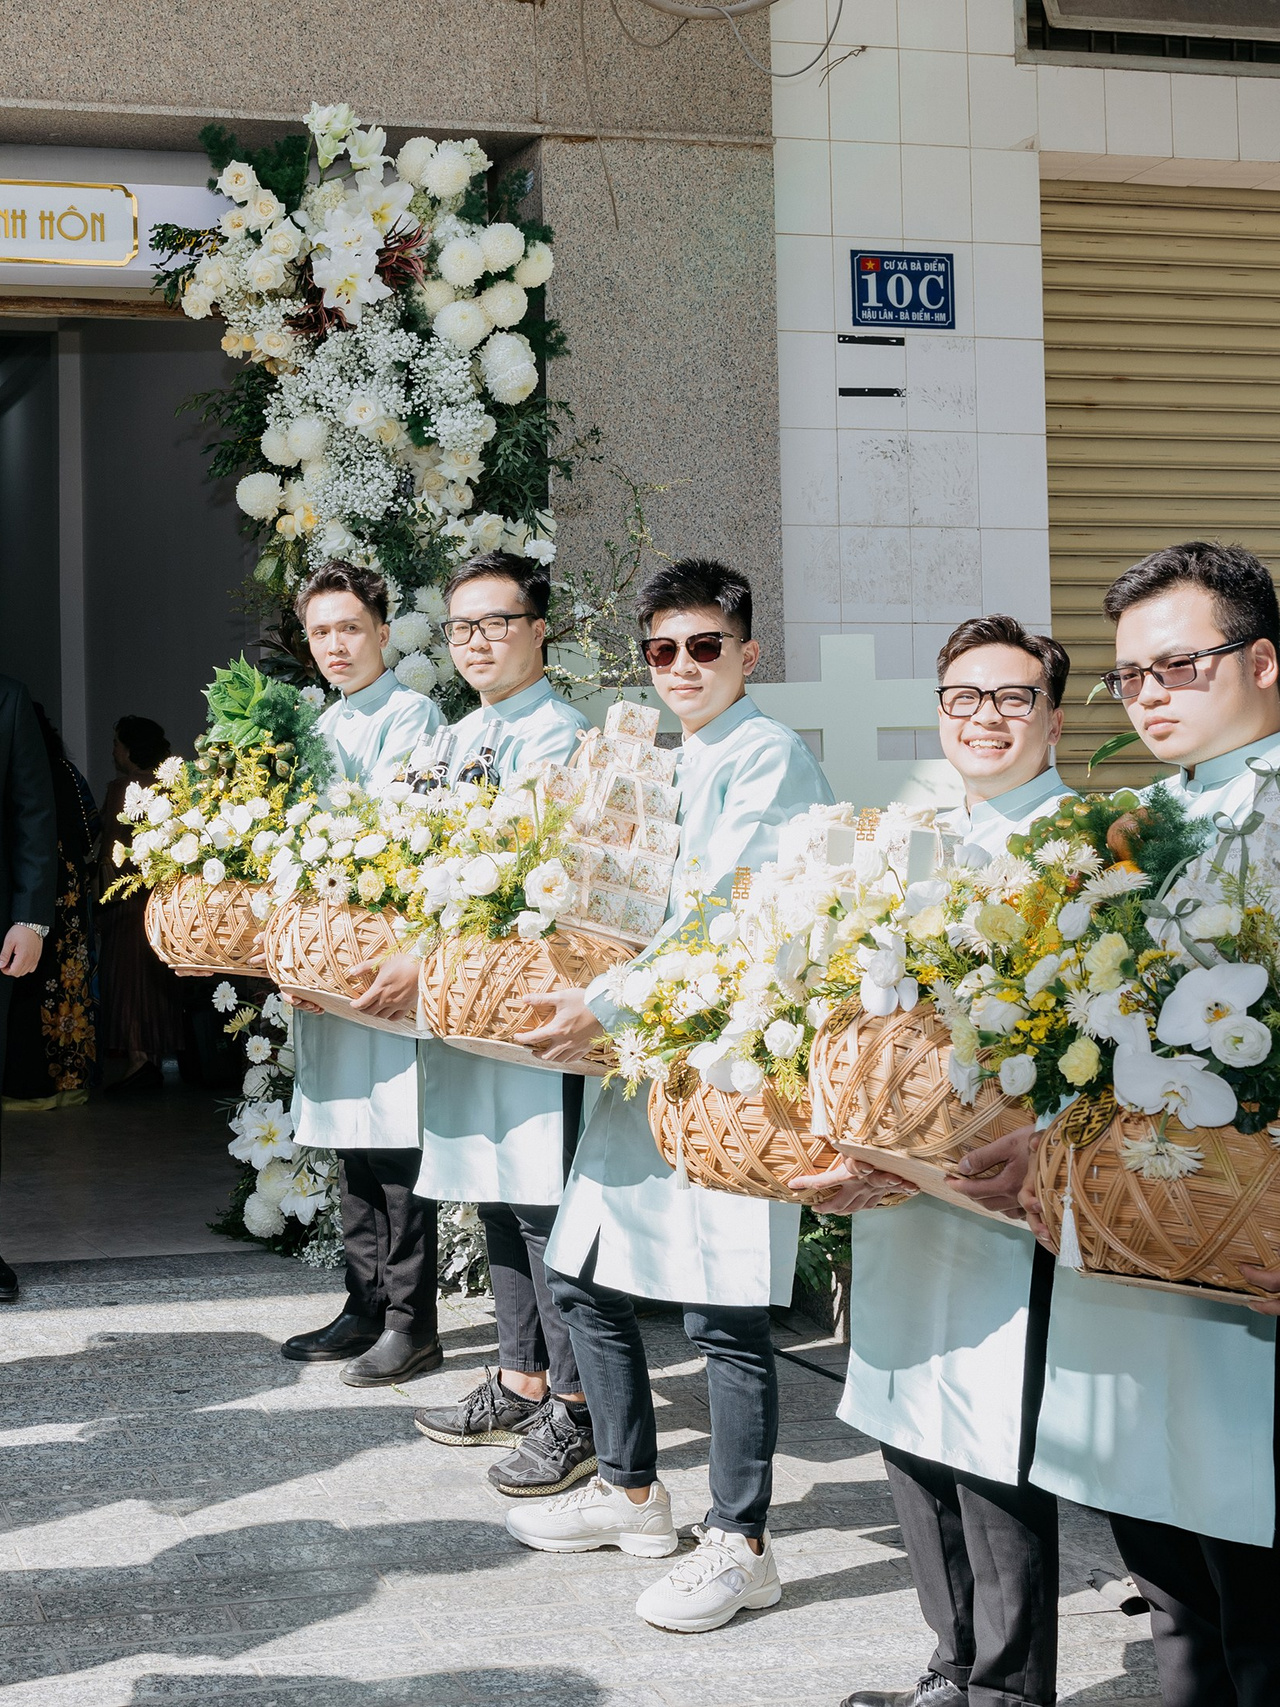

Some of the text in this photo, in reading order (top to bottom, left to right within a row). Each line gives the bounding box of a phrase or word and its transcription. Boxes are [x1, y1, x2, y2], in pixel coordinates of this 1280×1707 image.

[38, 205, 106, 242] HÔN
[910, 260, 922, 271] BÀ
[861, 272, 945, 309] 10C
[900, 309, 910, 321] BÀ
